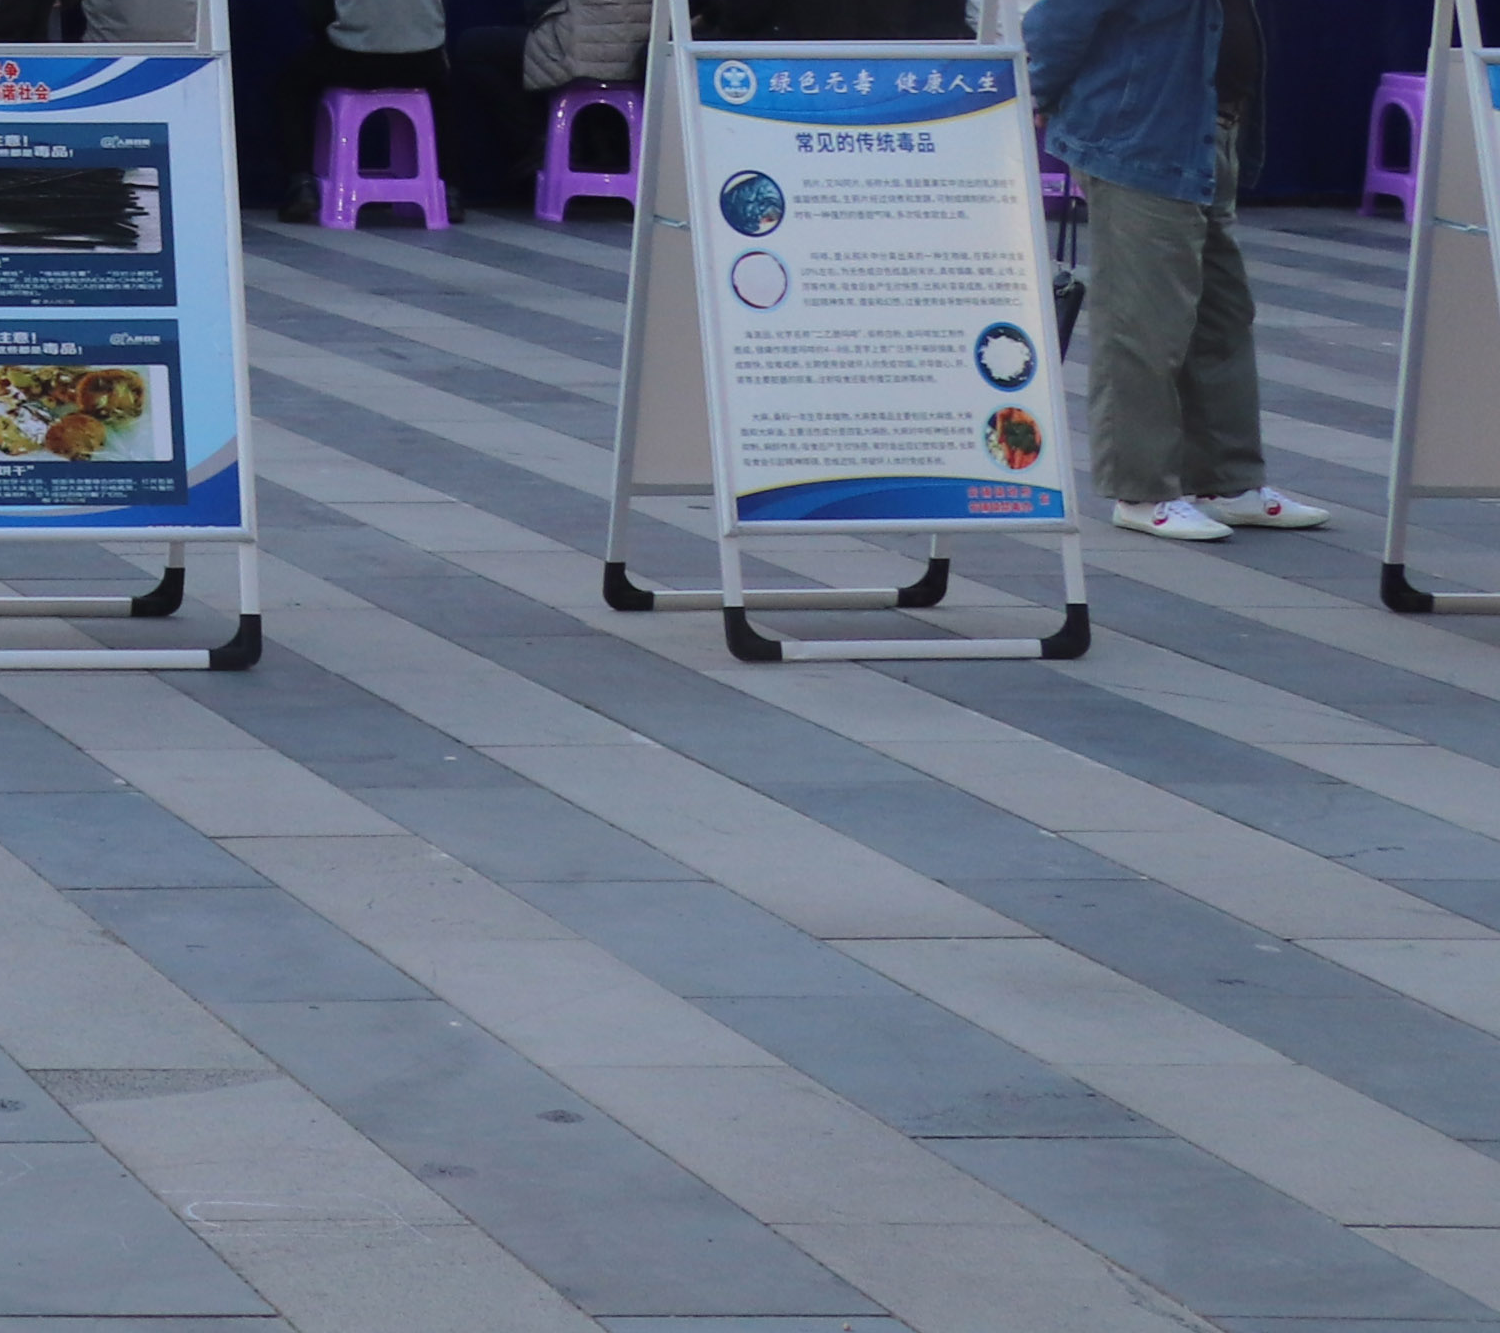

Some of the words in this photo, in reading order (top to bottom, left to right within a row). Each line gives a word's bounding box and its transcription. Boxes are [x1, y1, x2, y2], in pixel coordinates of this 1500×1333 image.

[769, 71, 875, 96] 绿色无毒
[895, 71, 999, 96] 健康人生
[795, 132, 936, 154] 常见的传统毒品
